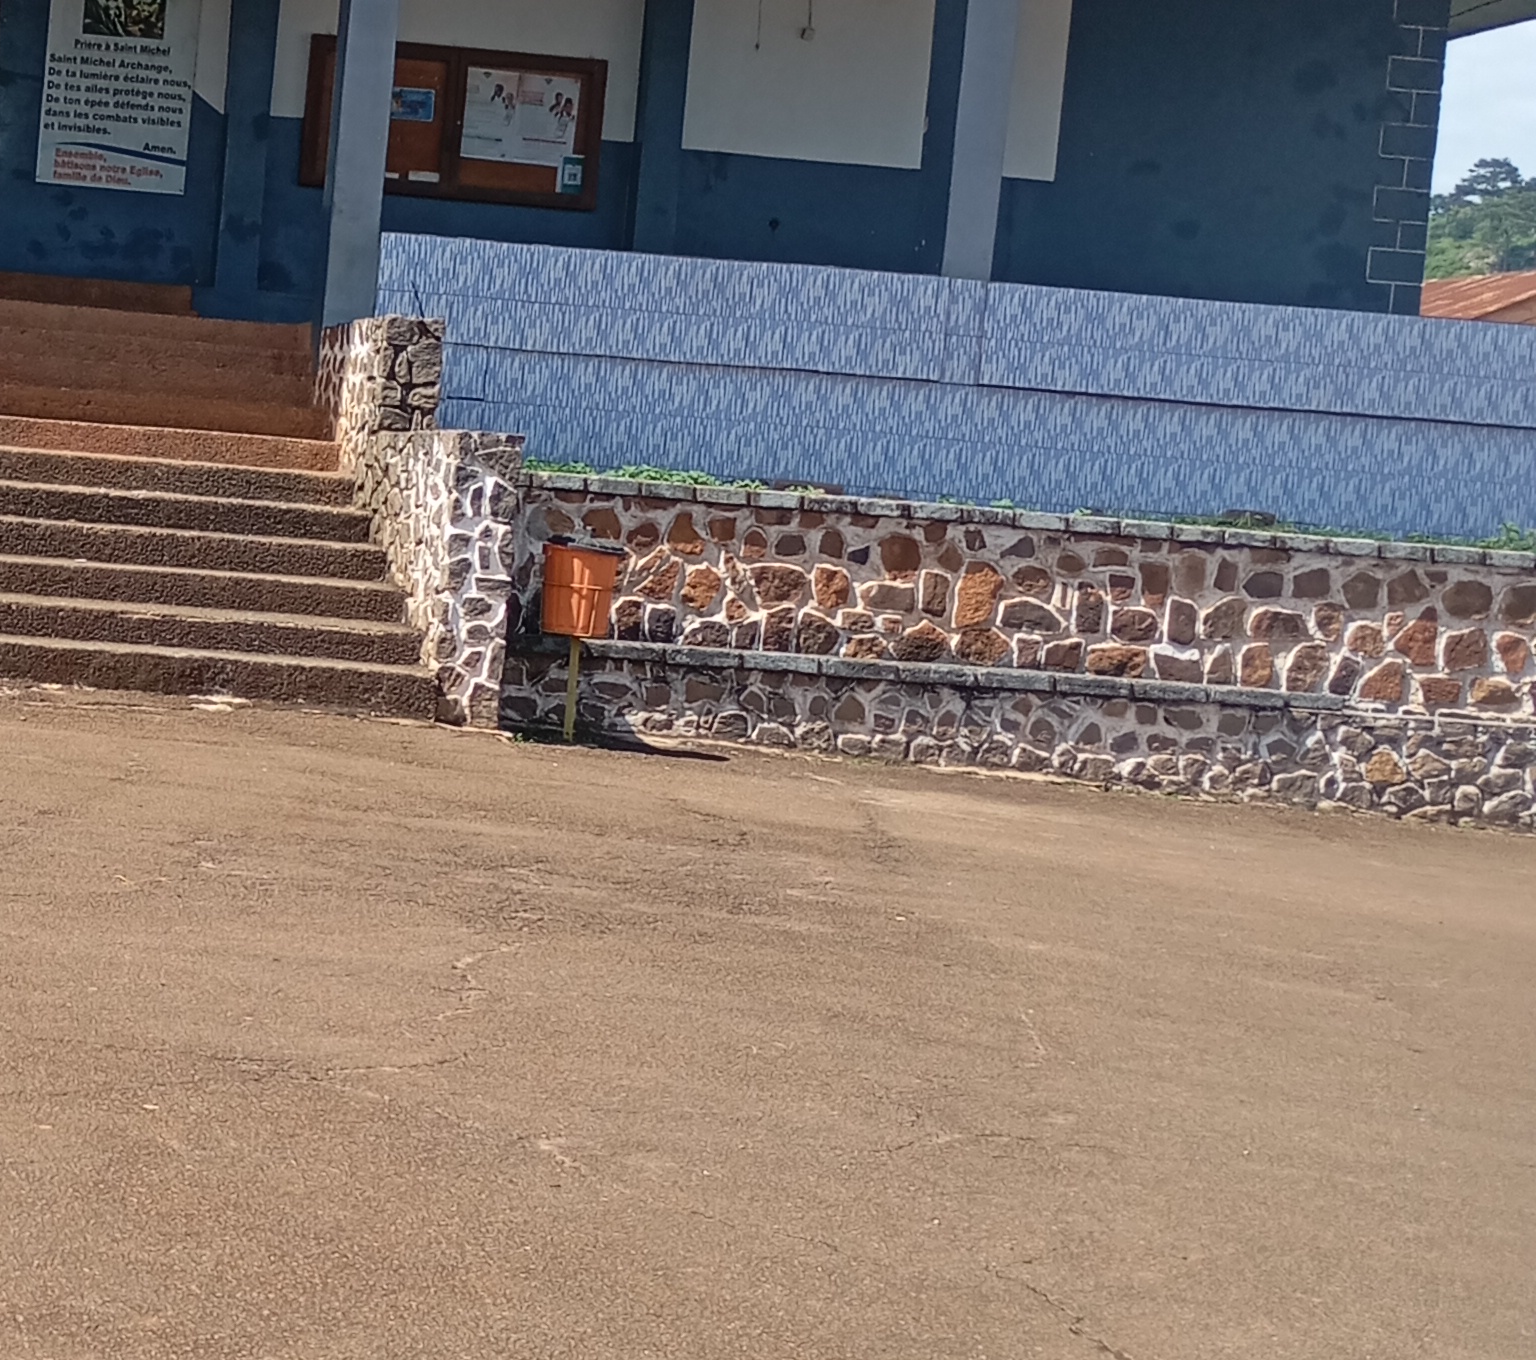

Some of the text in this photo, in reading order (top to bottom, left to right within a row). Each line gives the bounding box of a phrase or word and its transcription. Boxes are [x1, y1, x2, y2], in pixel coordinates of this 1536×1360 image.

[74, 39, 171, 56] Prière à Saint Michel
[49, 53, 173, 74] Saint Michel Archange,
[48, 67, 192, 90] De ta lumière éclaire nous,
[47, 80, 186, 102] De tes ailes protège nous,
[46, 93, 183, 114] De ton épée défends nous
[44, 107, 182, 128] dans les combats visibles
[43, 121, 111, 135] et invisibles.
[55, 148, 107, 163] Ensemble,
[142, 142, 176, 154] Amen.
[53, 170, 131, 185] famille de Dieu.
[99, 164, 126, 174] notre
